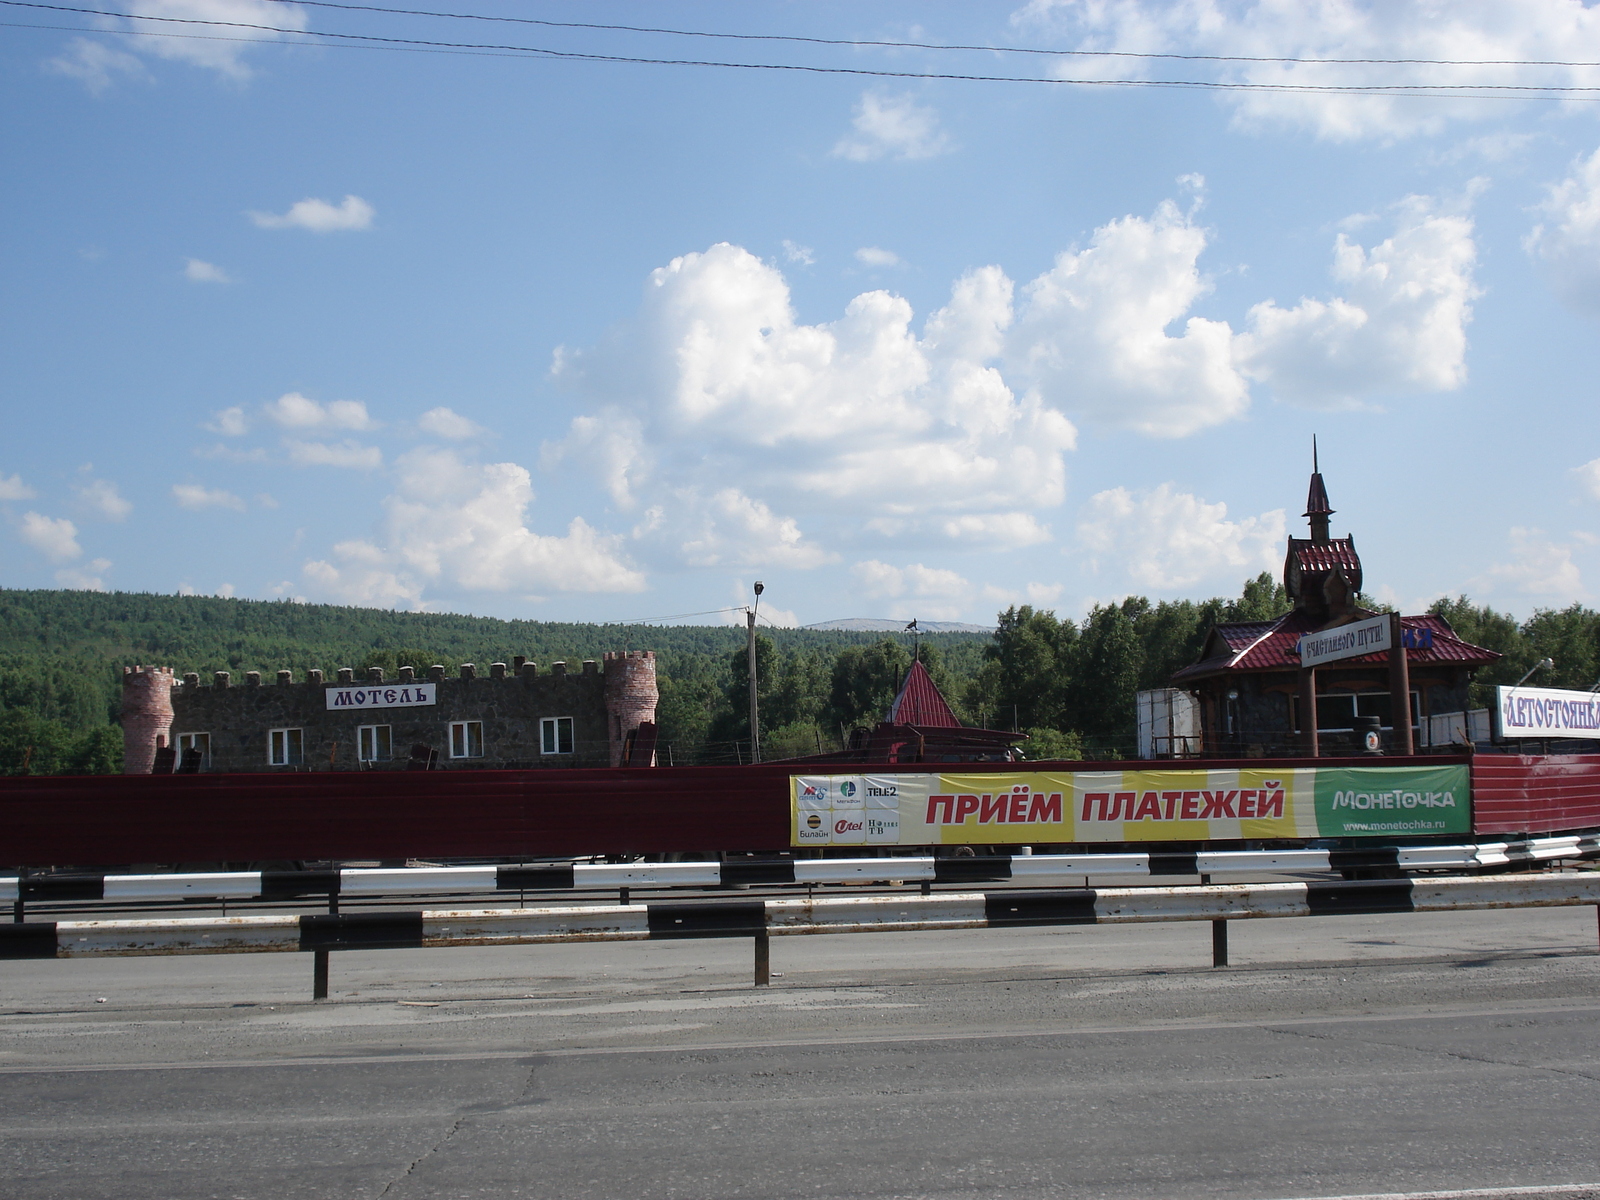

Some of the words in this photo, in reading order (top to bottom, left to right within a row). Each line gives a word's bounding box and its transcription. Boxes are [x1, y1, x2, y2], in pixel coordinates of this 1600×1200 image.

[1357, 622, 1384, 650] ПУТИ!
[334, 687, 427, 706] МОТЕЛЬ
[867, 786, 897, 797] TELE2
[925, 786, 1062, 824] ПРИЁМ
[1081, 781, 1285, 822] ПЛАТЕЖЕЙ
[834, 820, 863, 834] Utel
[1343, 820, 1446, 831] www.monetochka.ru
